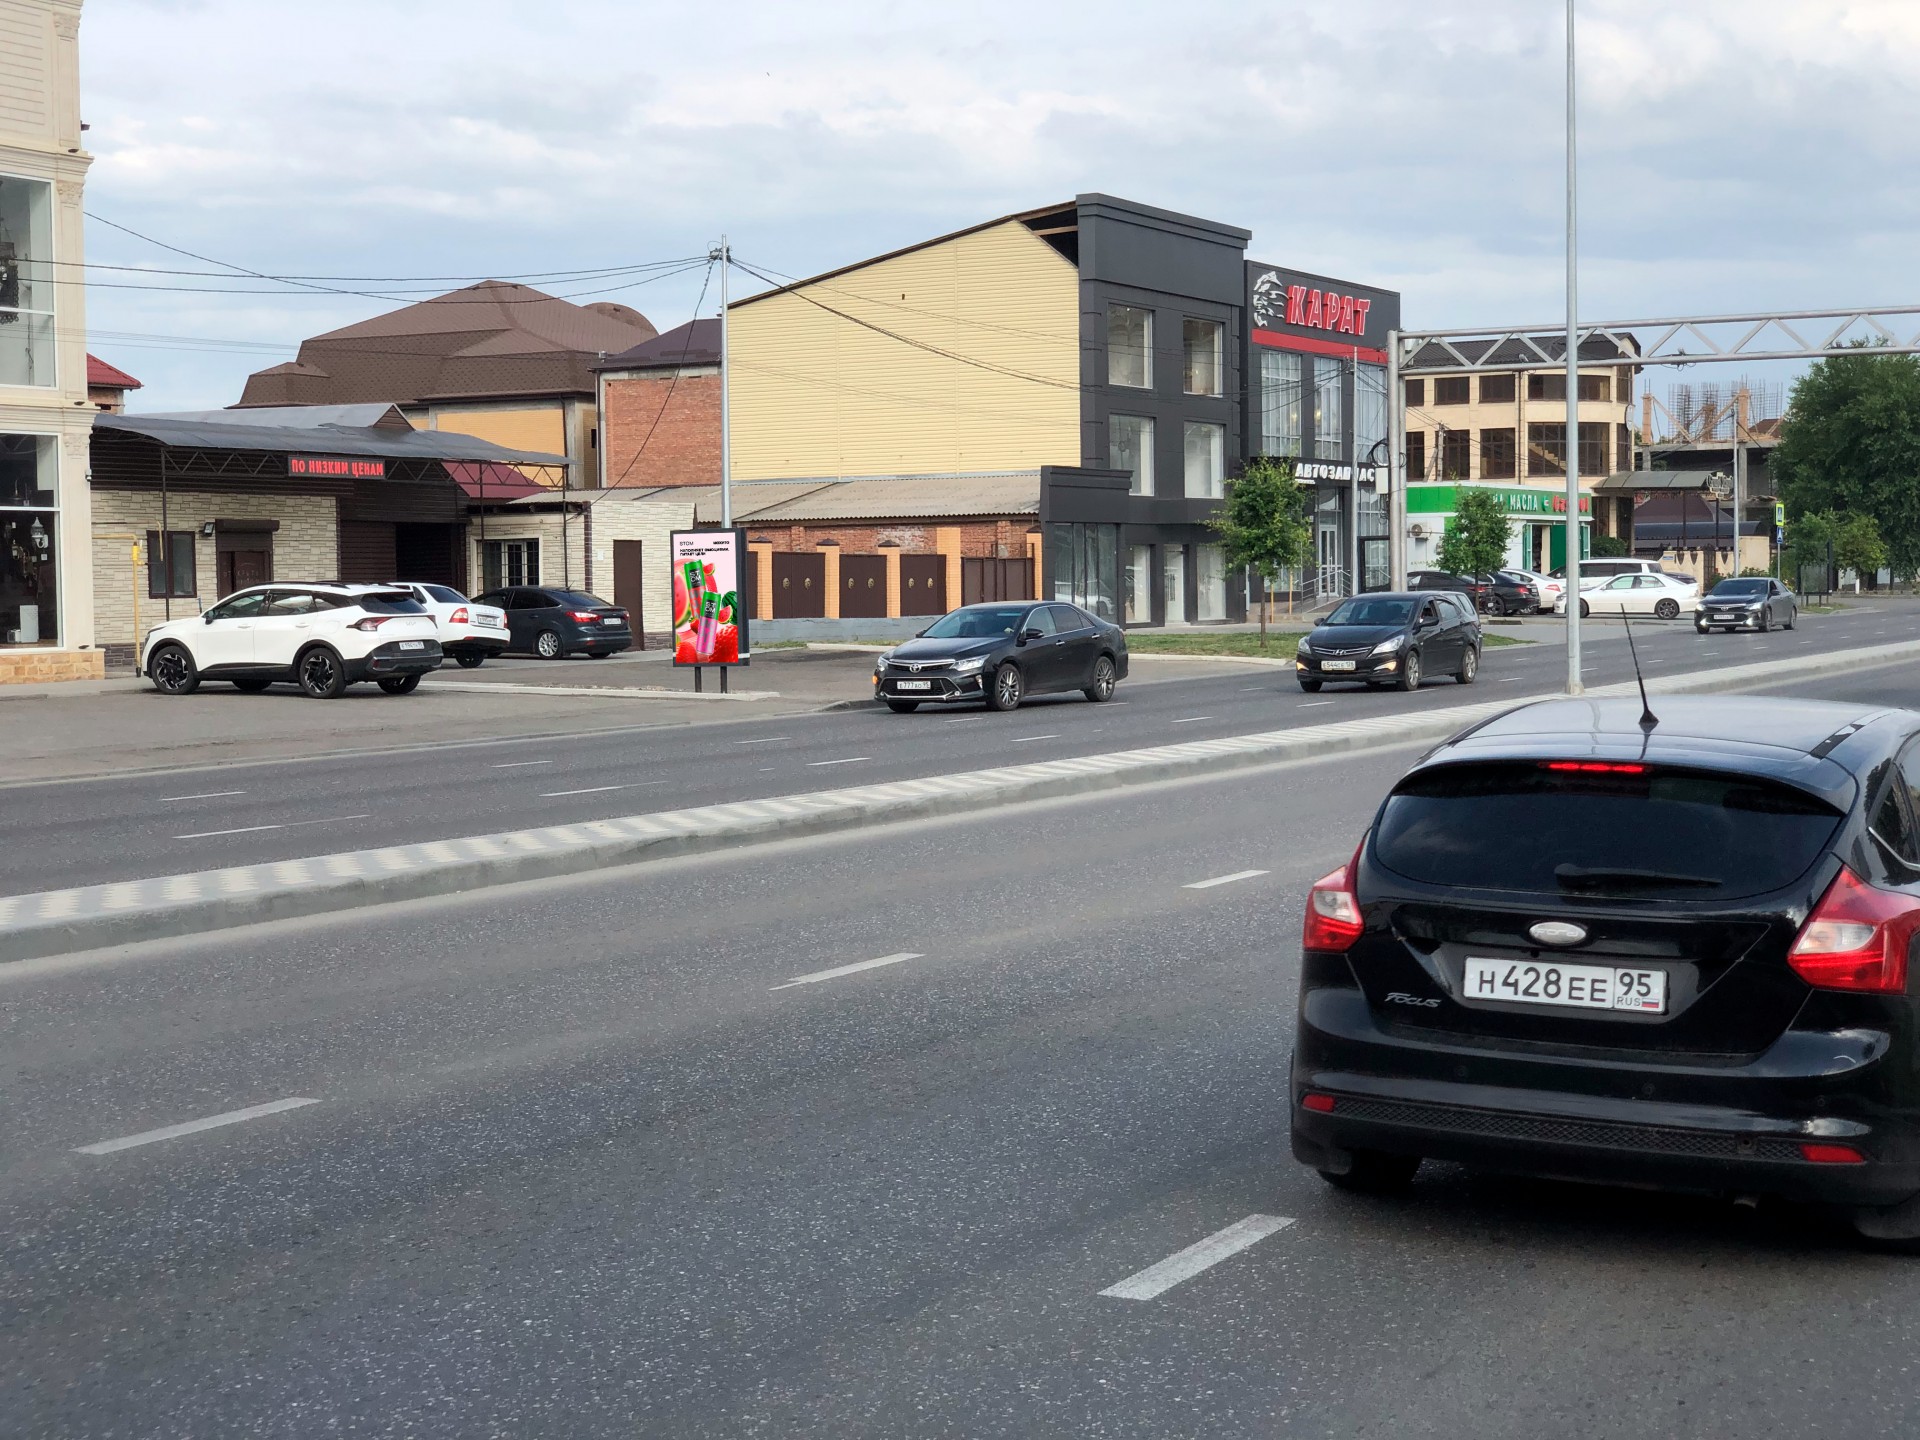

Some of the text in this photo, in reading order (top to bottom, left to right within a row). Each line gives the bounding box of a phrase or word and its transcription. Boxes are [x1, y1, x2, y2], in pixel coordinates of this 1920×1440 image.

[1286, 285, 1371, 336] КАРАТ
[291, 459, 384, 478] ПО НИЗКИМ ЦЕНАМ
[1295, 462, 1375, 482] АВТОЗАПАС
[1509, 494, 1538, 512] МАСЛА
[1479, 965, 1652, 1003] Н428ЕЕ 95
[1616, 996, 1641, 1006] RUS
